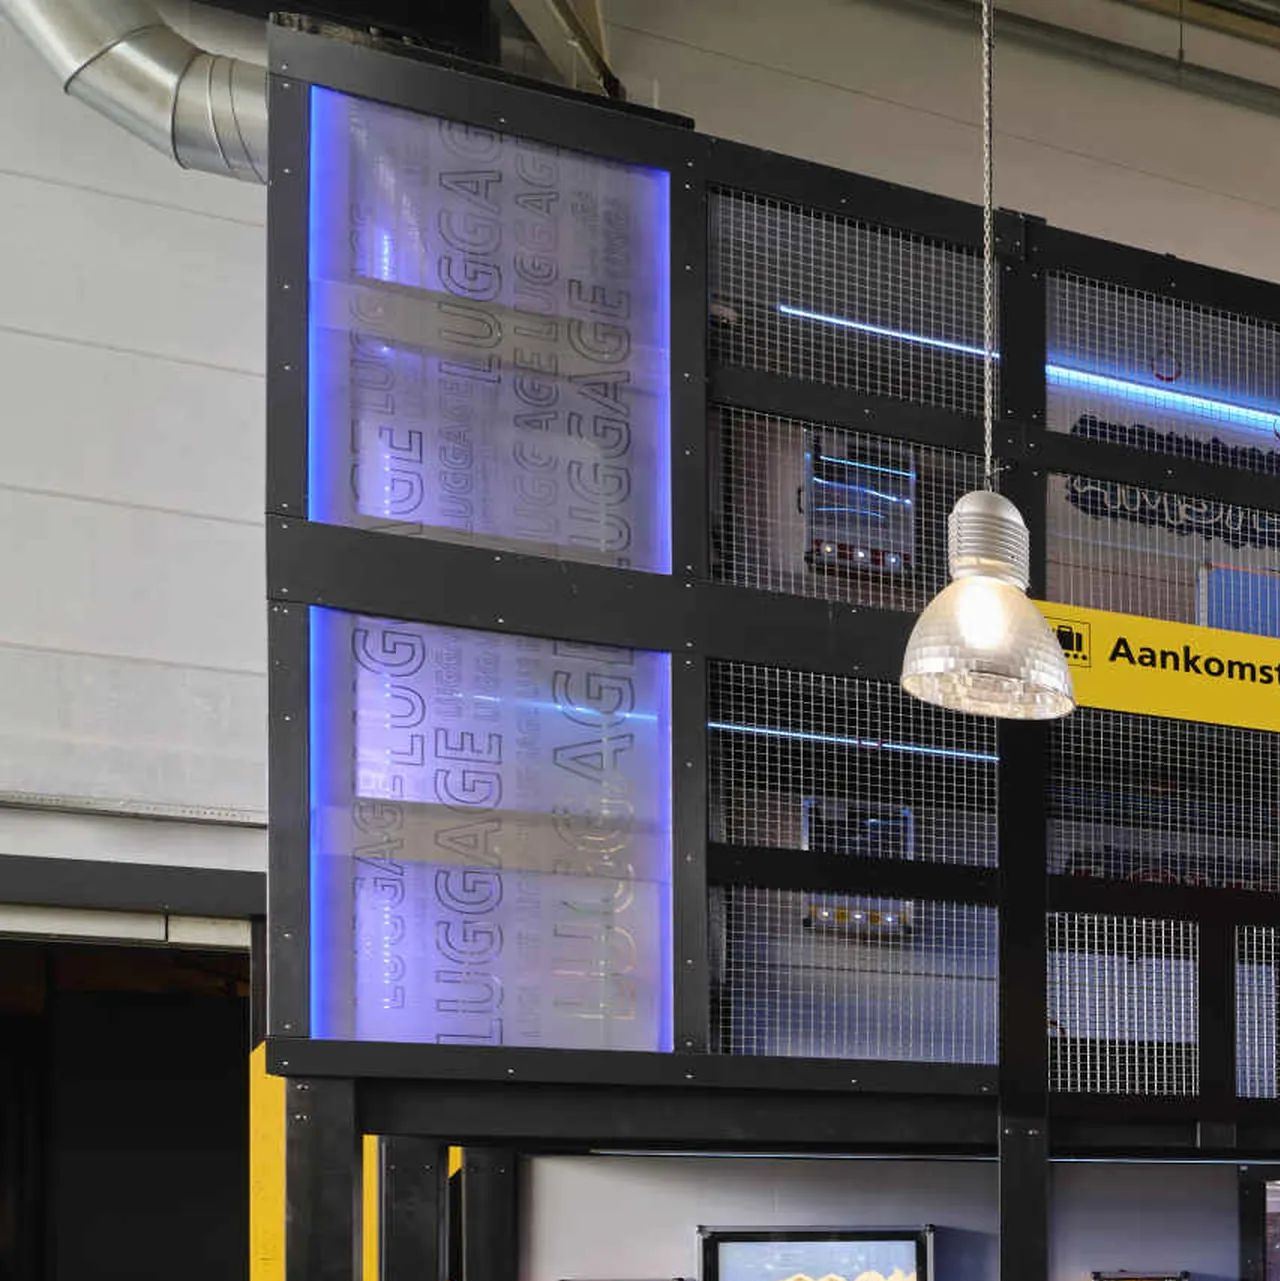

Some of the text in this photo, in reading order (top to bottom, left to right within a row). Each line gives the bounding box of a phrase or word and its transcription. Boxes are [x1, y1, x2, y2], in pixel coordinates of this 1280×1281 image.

[514, 142, 560, 343] LUGGAG
[567, 279, 632, 568] UGGAGE
[434, 727, 504, 1046] LUGGAGE
